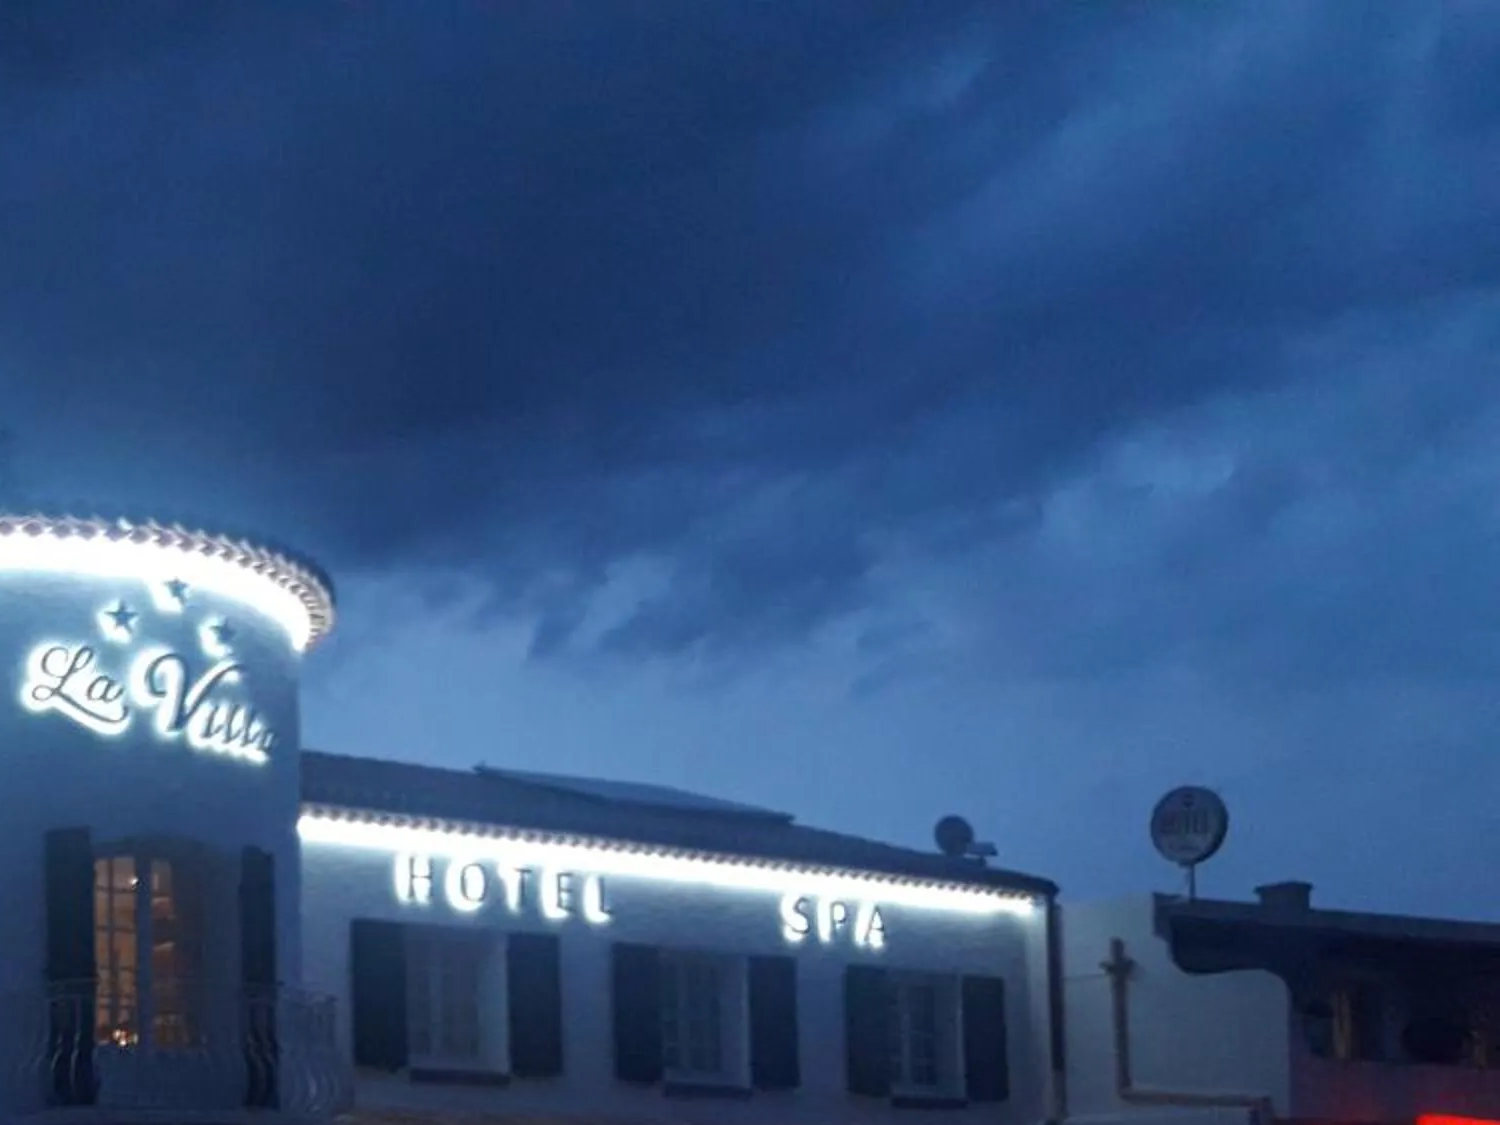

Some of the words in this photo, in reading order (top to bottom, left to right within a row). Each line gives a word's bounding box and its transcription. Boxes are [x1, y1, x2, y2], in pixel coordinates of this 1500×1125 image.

[31, 645, 130, 724] La
[143, 652, 276, 753] Villa
[404, 855, 613, 918] HOTEL
[789, 895, 887, 945] SPA
